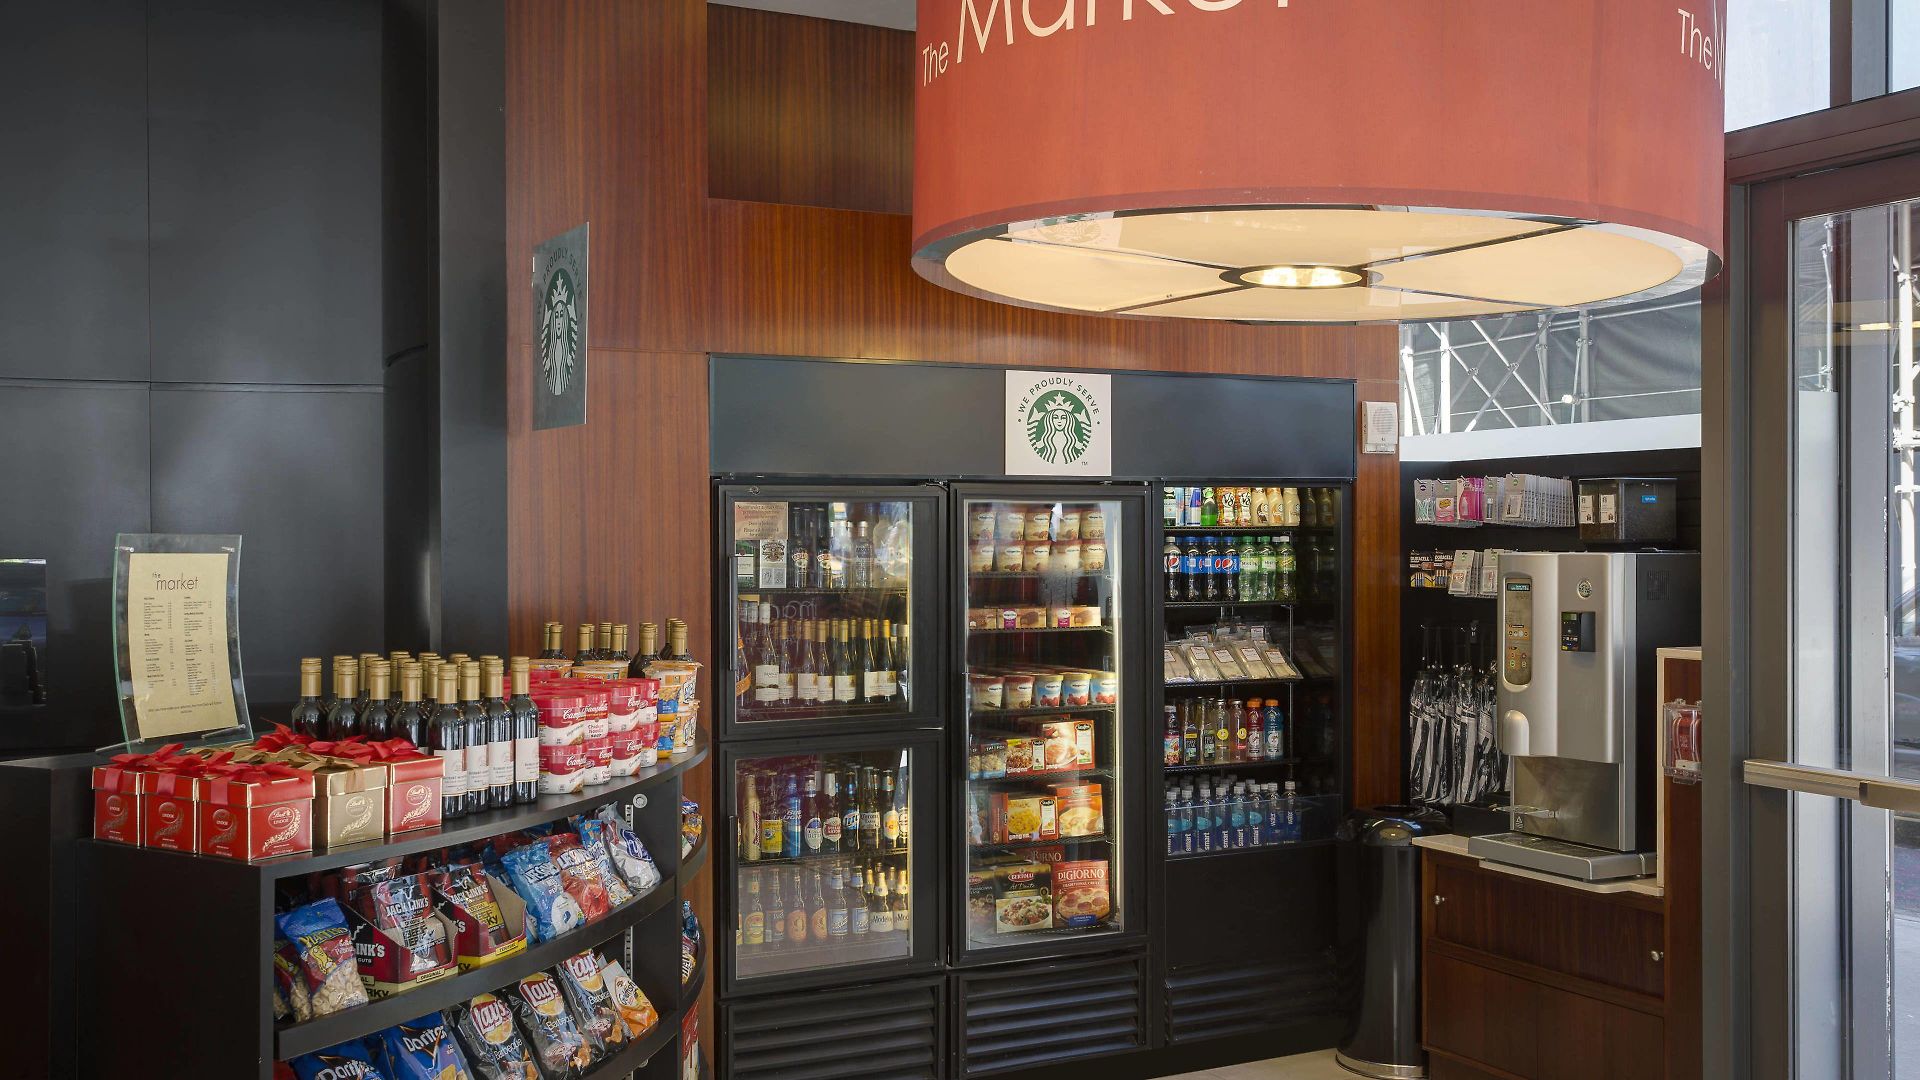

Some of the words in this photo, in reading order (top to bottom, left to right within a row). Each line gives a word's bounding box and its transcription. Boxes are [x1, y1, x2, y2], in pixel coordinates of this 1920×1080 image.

[1677, 8, 1712, 70] The
[922, 41, 949, 87] The
[1018, 396, 1029, 413] WE
[1029, 377, 1074, 396] PROUDLY
[1076, 384, 1100, 415] SERVE
[156, 572, 200, 591] market
[1058, 868, 1105, 881] DIGIORNO
[385, 902, 409, 918] JACK
[522, 978, 558, 1008] Lay's
[473, 999, 508, 1034] Lay's
